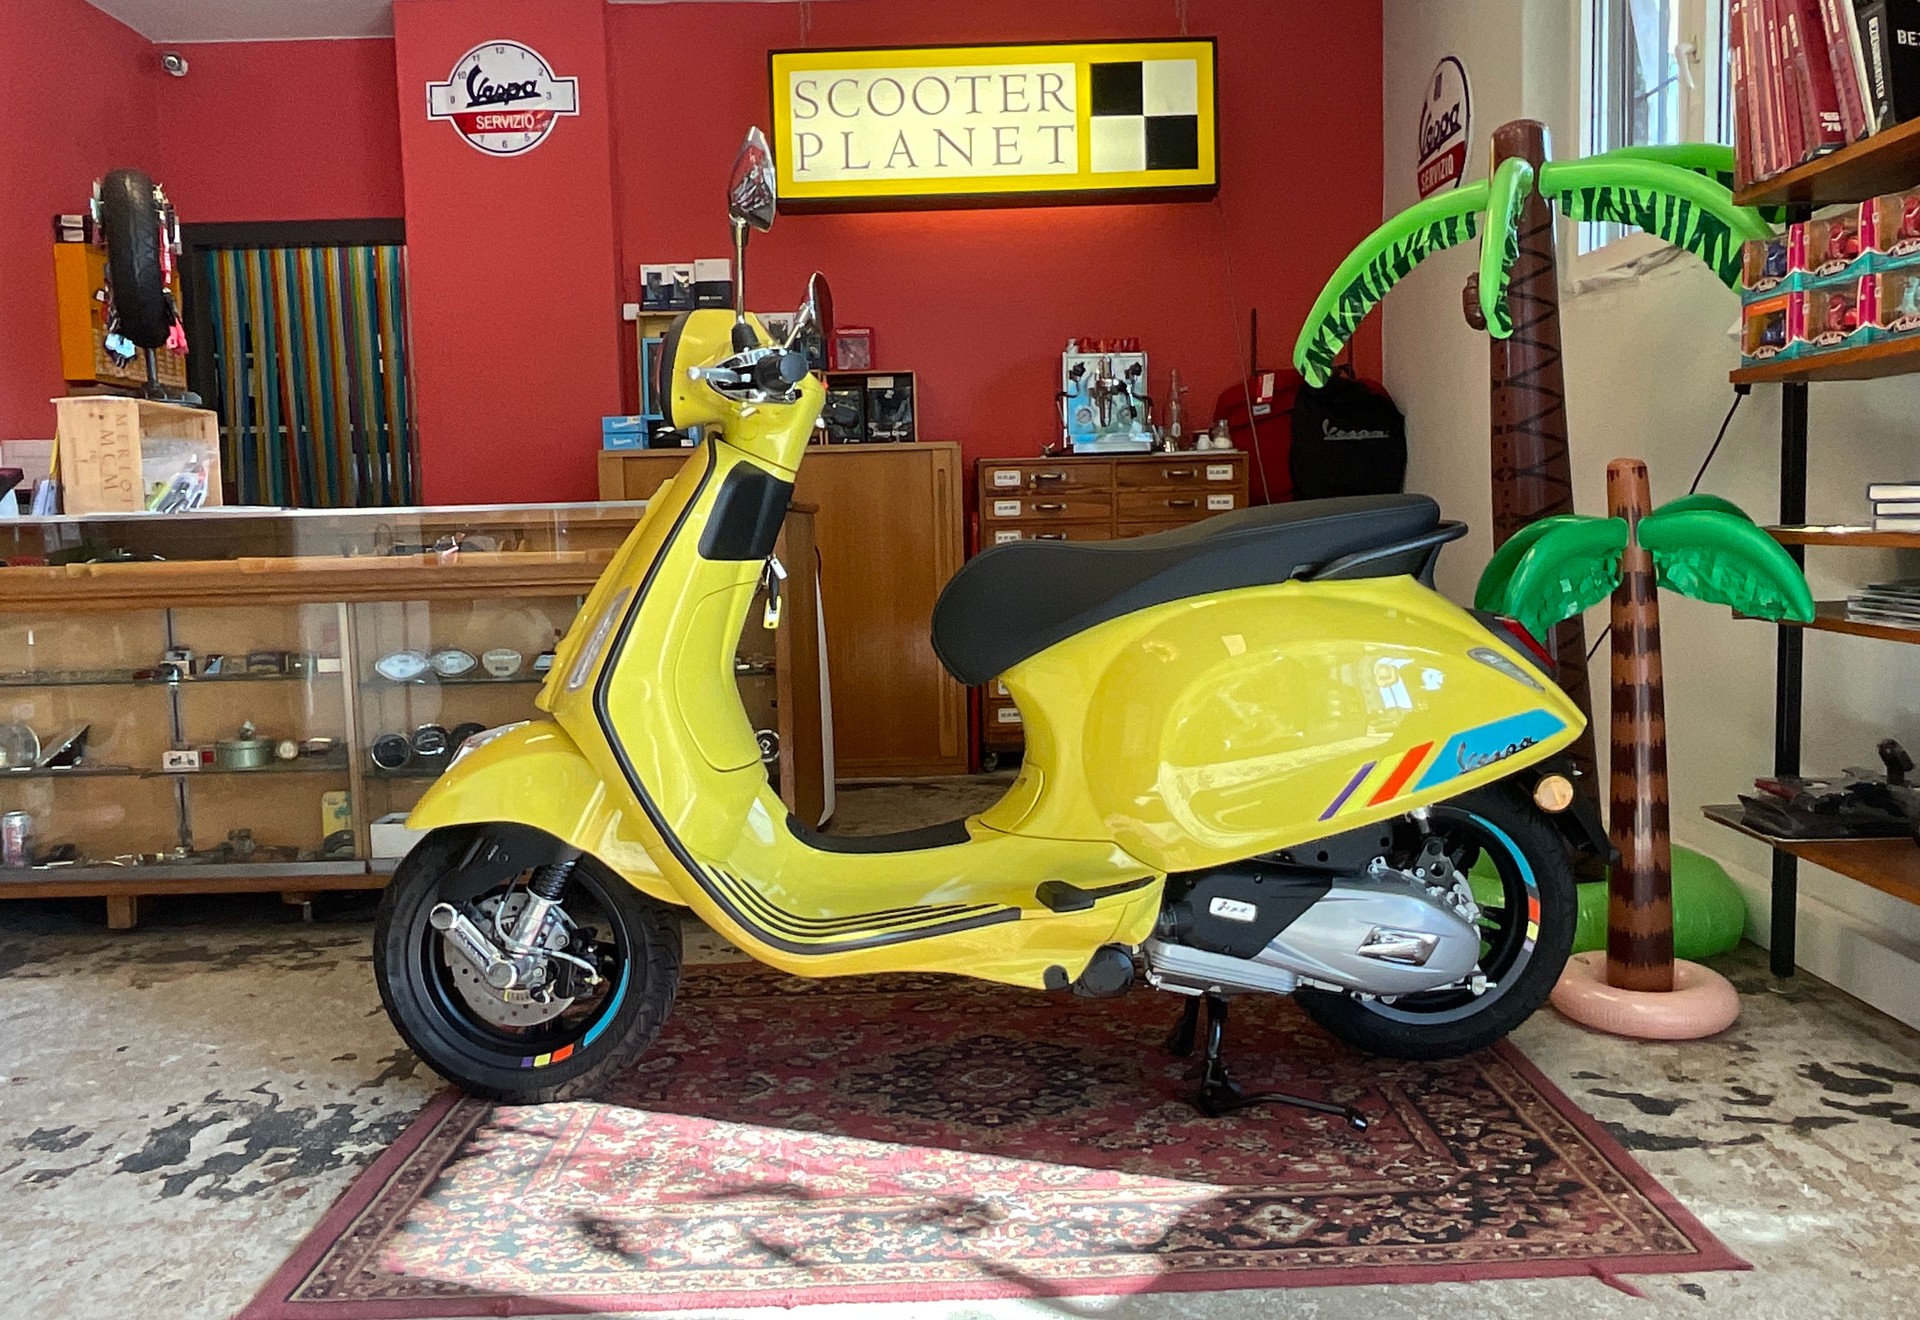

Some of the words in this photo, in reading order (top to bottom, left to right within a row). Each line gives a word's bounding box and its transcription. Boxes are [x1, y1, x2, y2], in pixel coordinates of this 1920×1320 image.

[1896, 28, 1920, 46] BE
[472, 54, 481, 62] 11
[457, 71, 467, 80] 10
[465, 64, 542, 108] Vespa
[538, 68, 544, 77] 2
[546, 92, 552, 100] 3
[793, 72, 1075, 120] SCOOTER
[475, 114, 535, 130] SERVIZIO
[1418, 101, 1462, 168] Vespa
[502, 140, 508, 149] 6
[794, 124, 1075, 172] PLANET
[1420, 153, 1454, 194] SERVIZIO
[115, 413, 134, 506] MERLOT
[1457, 736, 1540, 775] Vespa
